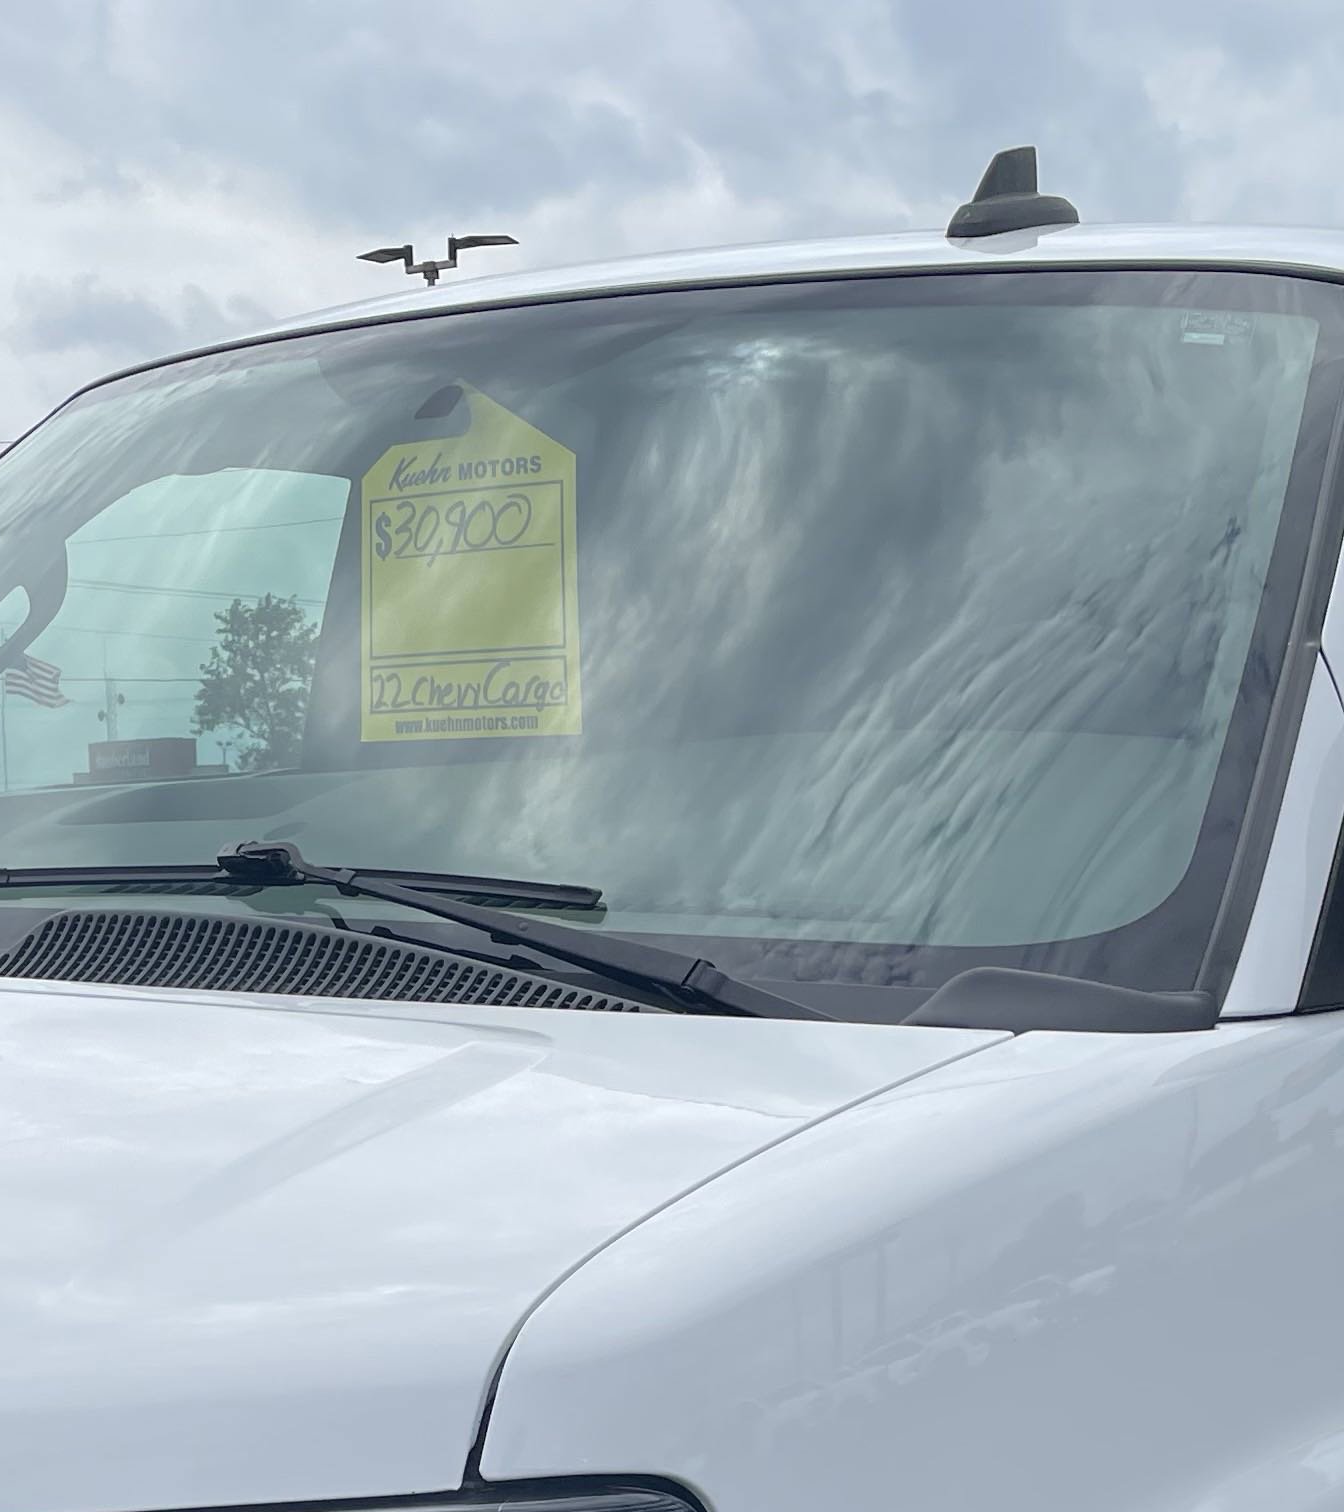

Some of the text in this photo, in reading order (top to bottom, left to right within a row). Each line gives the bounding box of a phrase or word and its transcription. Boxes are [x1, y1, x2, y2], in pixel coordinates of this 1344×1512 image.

[389, 452, 542, 492] Kuehn MOTORS
[373, 673, 411, 709] 22
[483, 661, 570, 712] Cargo
[395, 715, 539, 734] www.kuehnmotors.com
